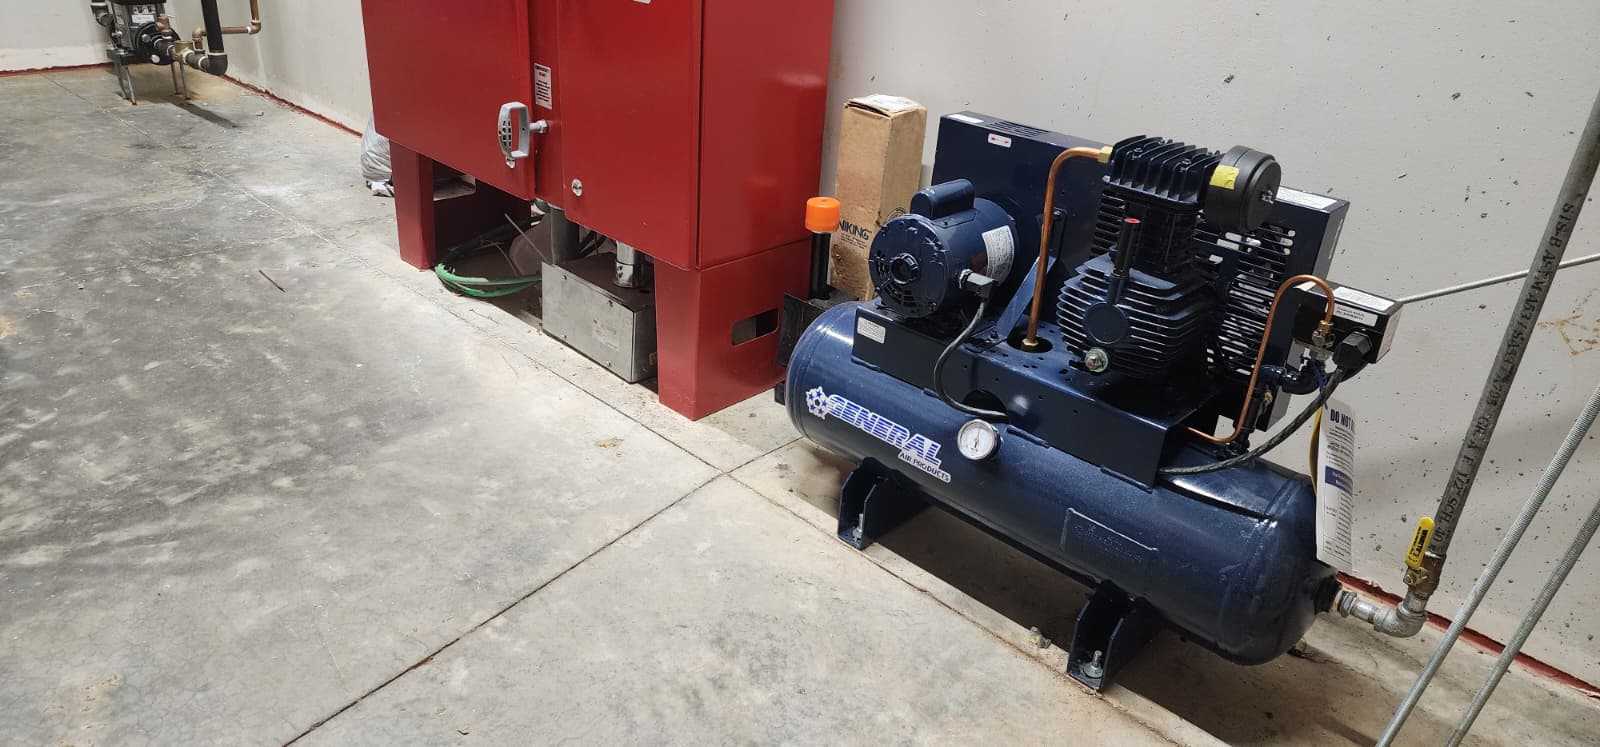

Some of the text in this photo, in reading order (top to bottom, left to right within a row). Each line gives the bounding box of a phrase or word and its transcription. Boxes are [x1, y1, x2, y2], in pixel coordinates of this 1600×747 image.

[839, 219, 871, 240] VIKING
[827, 396, 940, 466] GENERAL
[1330, 408, 1340, 423] DO
[1341, 413, 1351, 430] NOT
[899, 451, 950, 480] AIR PRODUCTS
